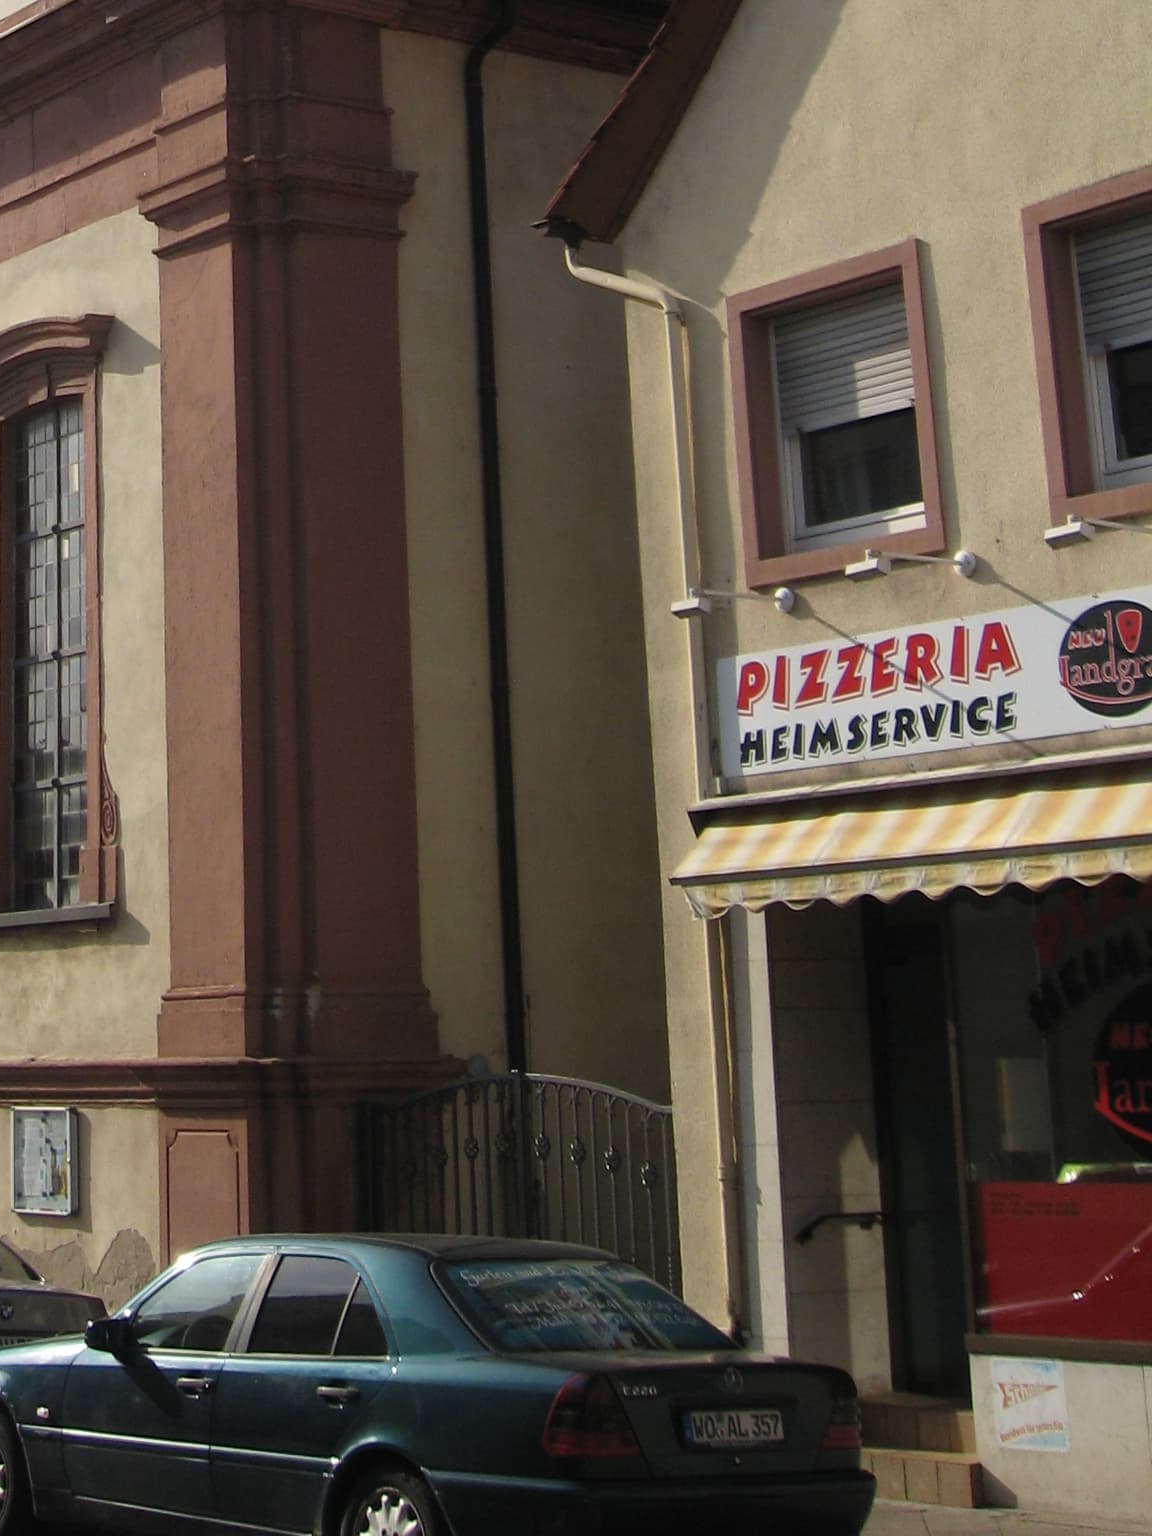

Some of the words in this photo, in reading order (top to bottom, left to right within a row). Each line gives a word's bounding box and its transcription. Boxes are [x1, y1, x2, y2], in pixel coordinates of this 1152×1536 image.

[1068, 627, 1106, 650] NEU
[737, 621, 1021, 716] PIZZERIA
[740, 692, 1017, 767] HEIMSERVICE
[693, 1415, 717, 1439] WO
[727, 1415, 749, 1438] AL
[752, 1414, 780, 1437] 357
